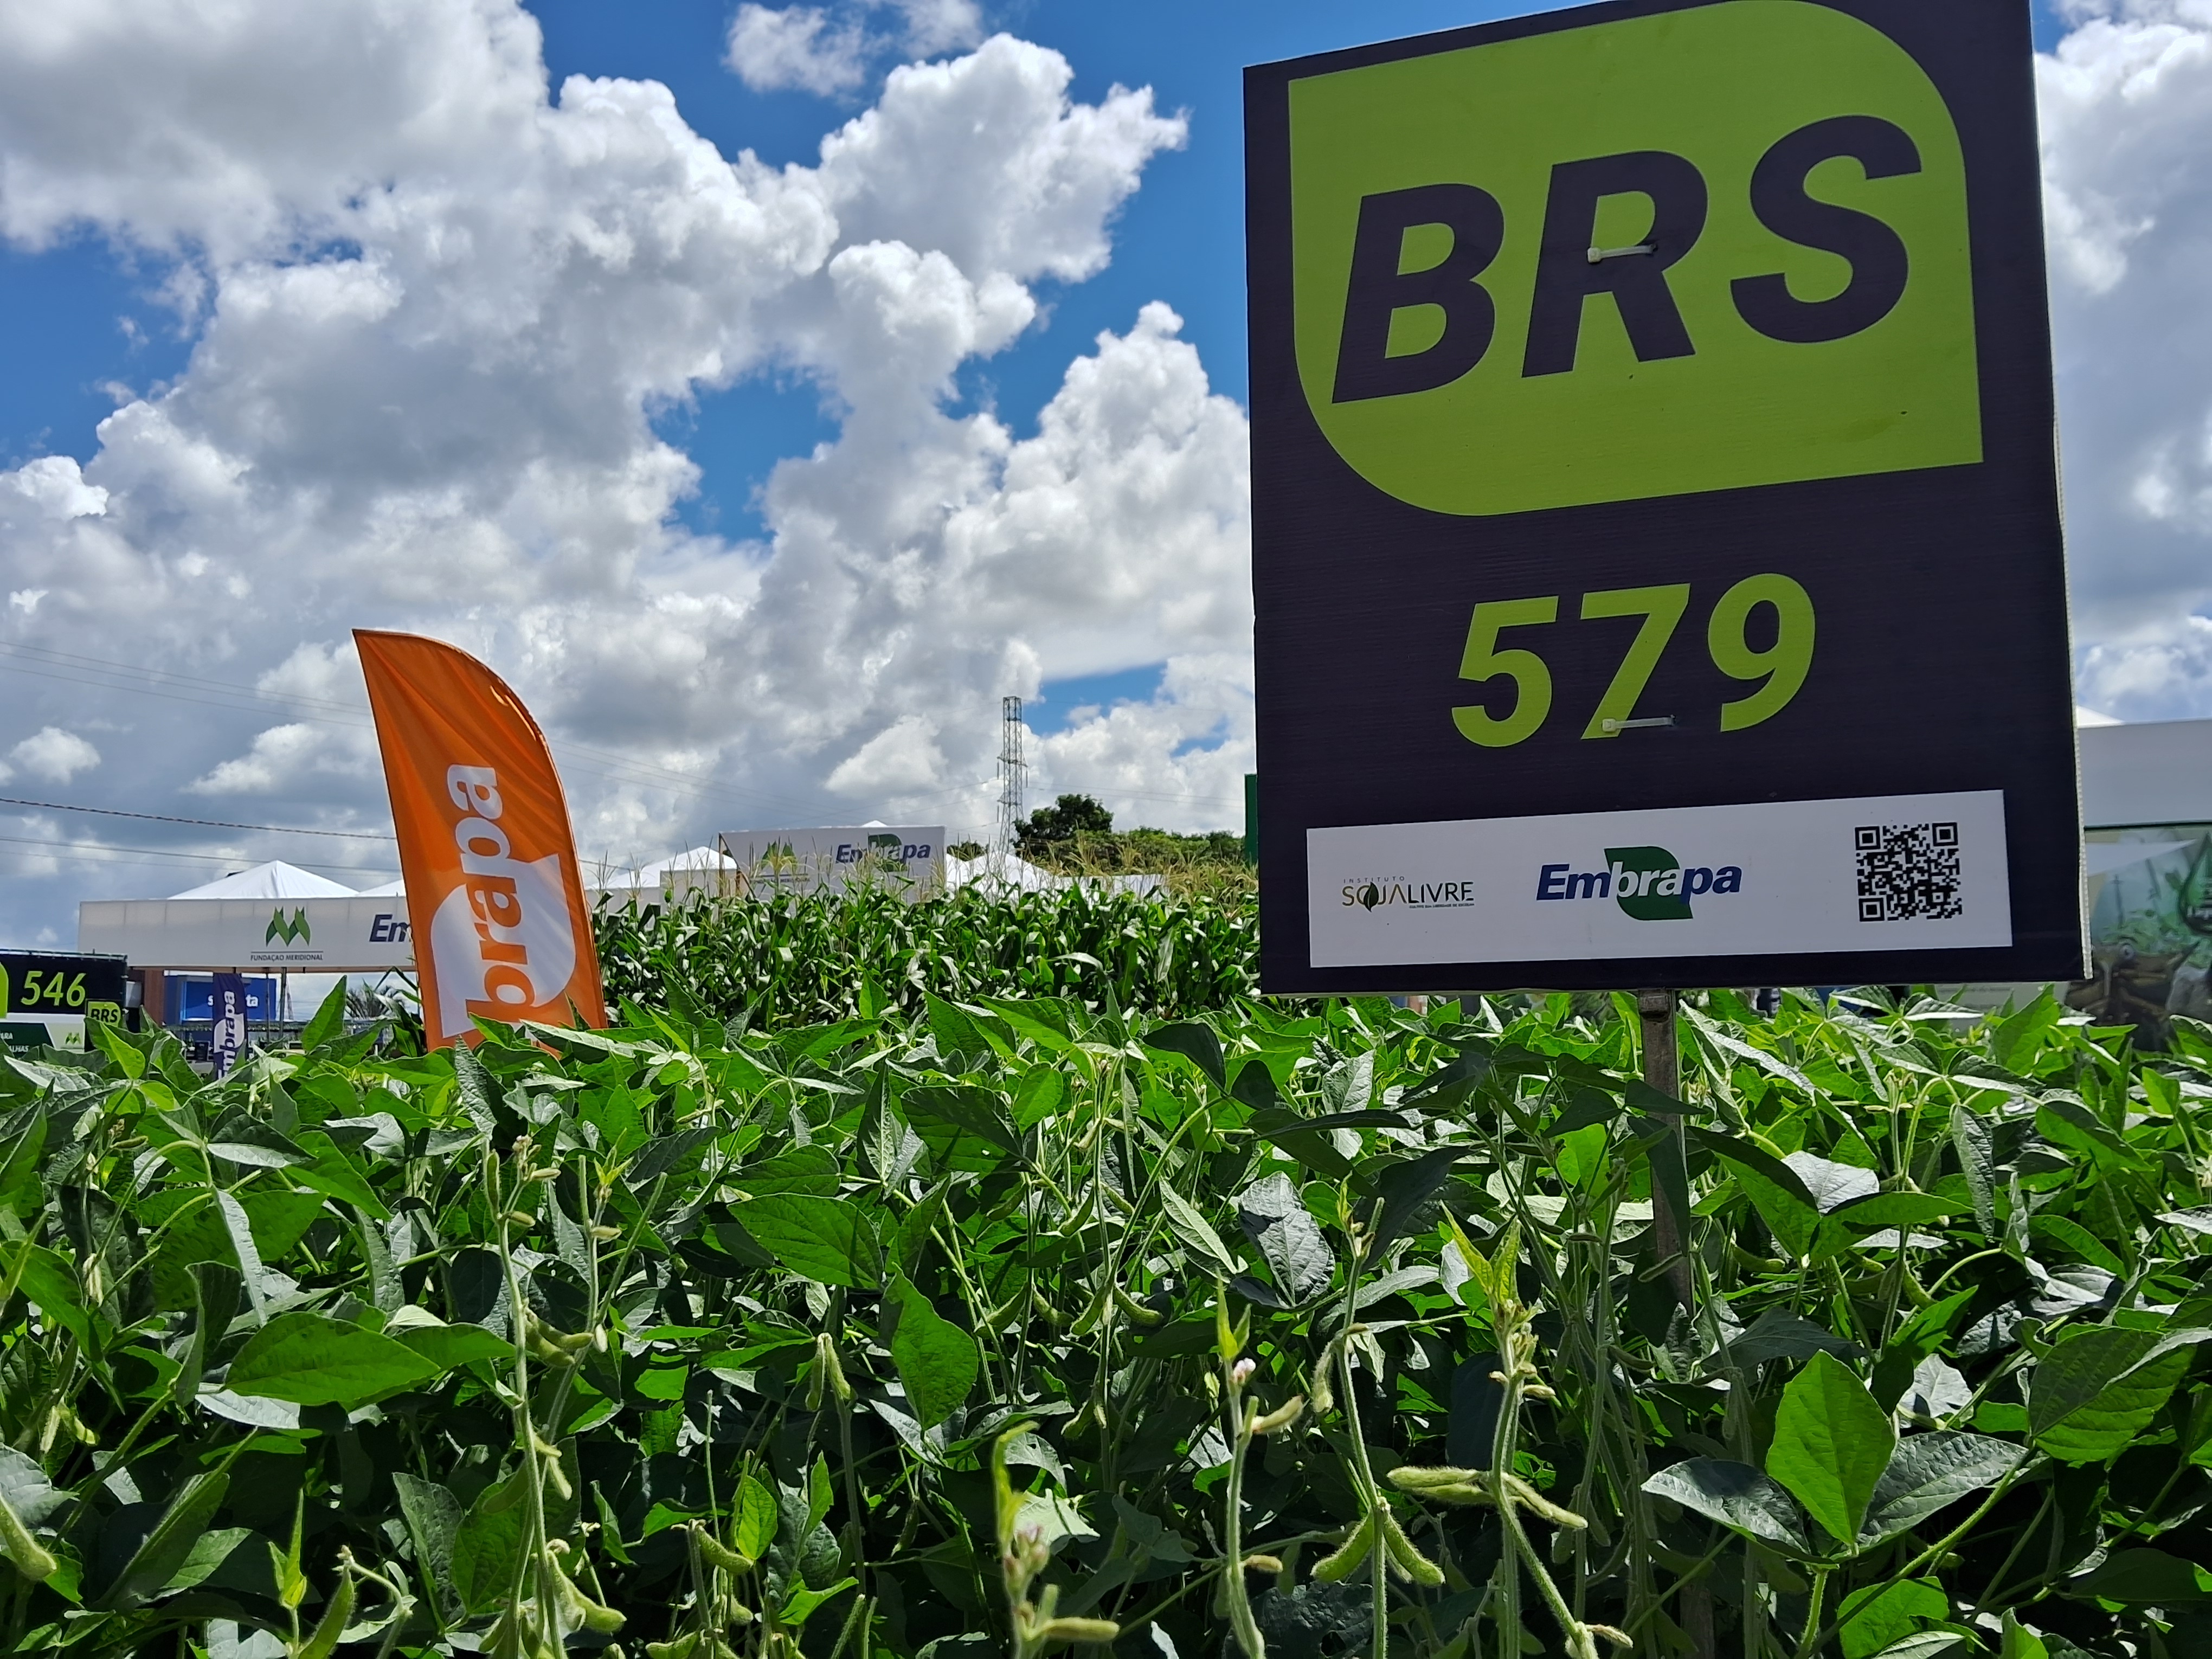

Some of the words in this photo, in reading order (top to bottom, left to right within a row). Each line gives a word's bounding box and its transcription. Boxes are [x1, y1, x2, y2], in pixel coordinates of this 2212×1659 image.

[1332, 114, 1922, 404] BRS
[1451, 573, 1816, 748] 579
[447, 763, 536, 1027] brapa
[1343, 876, 1405, 884] INSTITUTO
[1536, 861, 1742, 904] Embrapa
[21, 970, 86, 1007] 546
[91, 1008, 118, 1023] BRS
